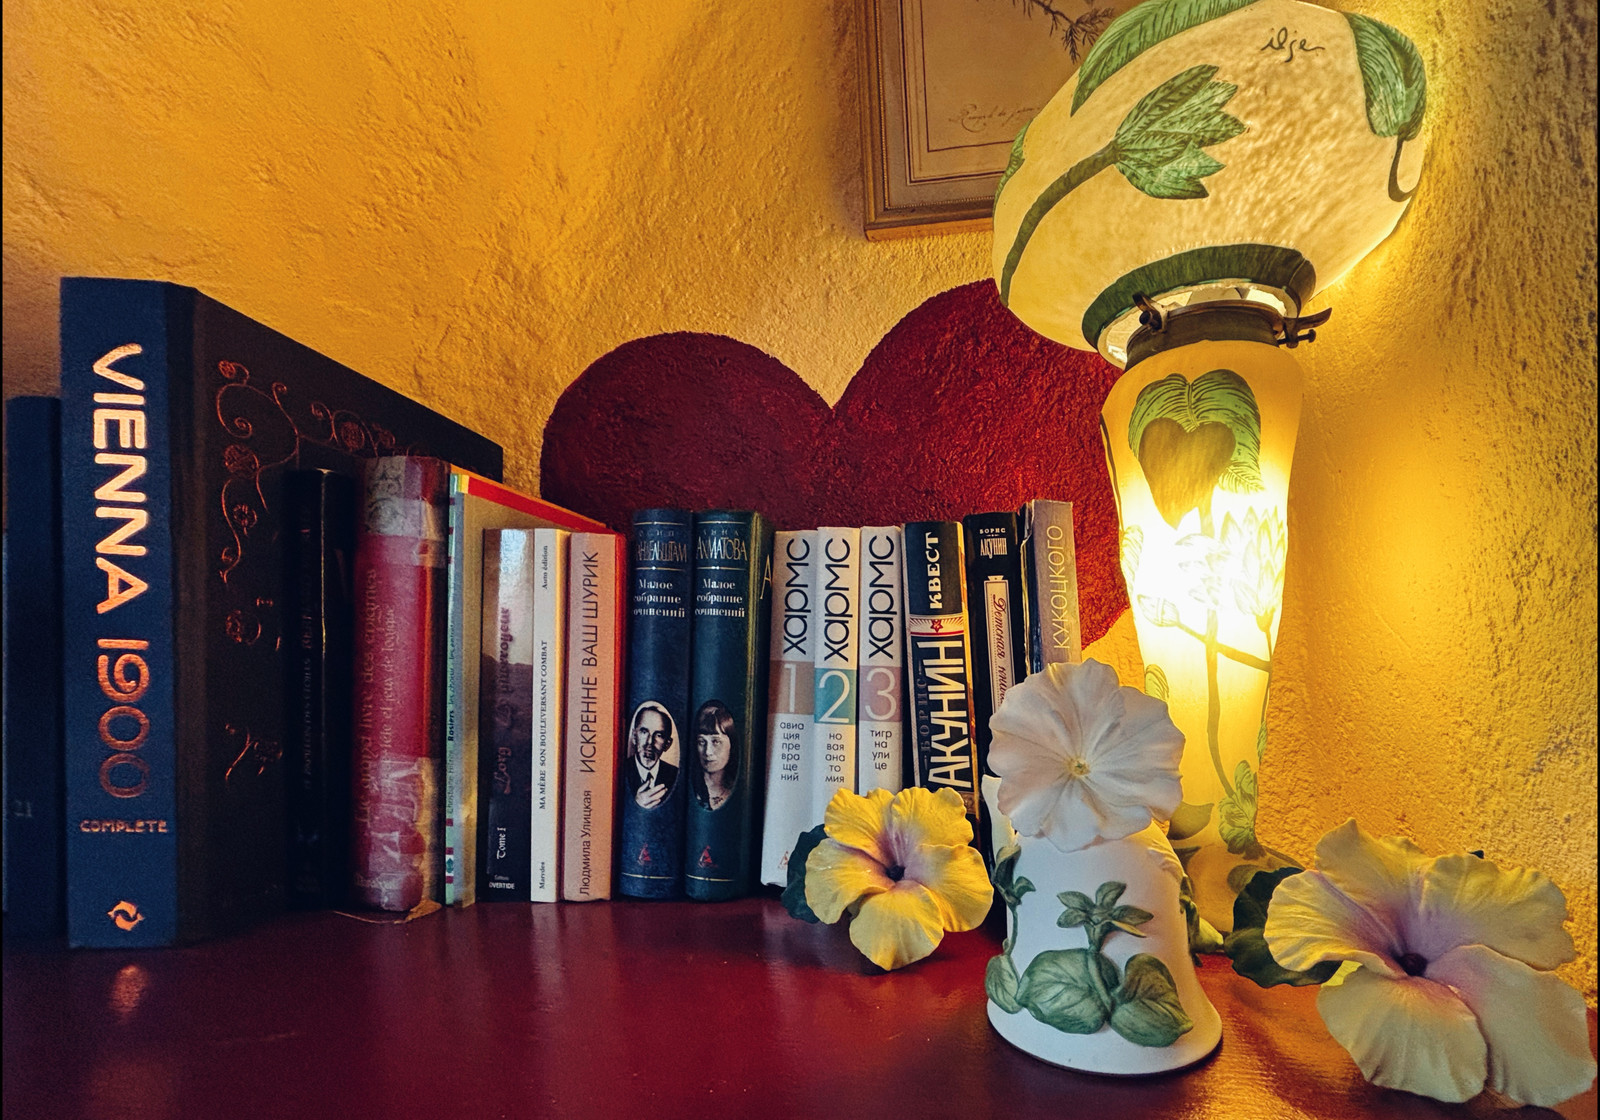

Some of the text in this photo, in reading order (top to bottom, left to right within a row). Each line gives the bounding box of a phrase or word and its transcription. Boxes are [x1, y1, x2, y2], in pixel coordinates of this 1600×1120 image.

[979, 527, 1007, 535] БОРИС
[695, 535, 748, 562] АХМАТОВА
[980, 537, 1008, 559] АКУНИН
[541, 545, 549, 571] édition
[92, 342, 150, 799] VIENNA 1900
[925, 531, 943, 609] КВЕСТ
[638, 578, 673, 590] Малое
[702, 578, 736, 590] Малое
[1046, 525, 1071, 649] КУКОЦКОГО
[696, 592, 743, 605] собрание
[633, 607, 686, 618] очинений
[694, 607, 746, 618] сочинений
[992, 594, 1007, 660] Детская
[580, 551, 599, 773] ИСКРЕННЕ ВАШ ШУРИК
[784, 663, 797, 713] 1
[864, 667, 897, 721] 3
[818, 670, 850, 724] 2
[540, 678, 548, 747] BOULEVERSANT
[916, 676, 932, 753] БОРИС
[917, 640, 972, 789] АКУНИН
[447, 710, 455, 742] Rosiers
[780, 722, 805, 731] авиа
[783, 733, 800, 741] ция
[870, 729, 893, 739] тигр
[782, 743, 801, 752] пре
[826, 743, 845, 751] вая
[874, 740, 888, 748] на
[539, 750, 547, 767] SON
[781, 753, 801, 762] вра
[825, 754, 846, 762] ана
[871, 751, 890, 760] ули
[782, 764, 798, 772] ще
[829, 764, 842, 772] то
[874, 762, 888, 770] це
[537, 769, 547, 795] MÈRE
[780, 772, 799, 781] ний
[539, 797, 546, 810] MA
[79, 819, 168, 833] COMPLETE
[496, 832, 507, 860] Tome
[579, 790, 593, 897] Людмила Улицкая
